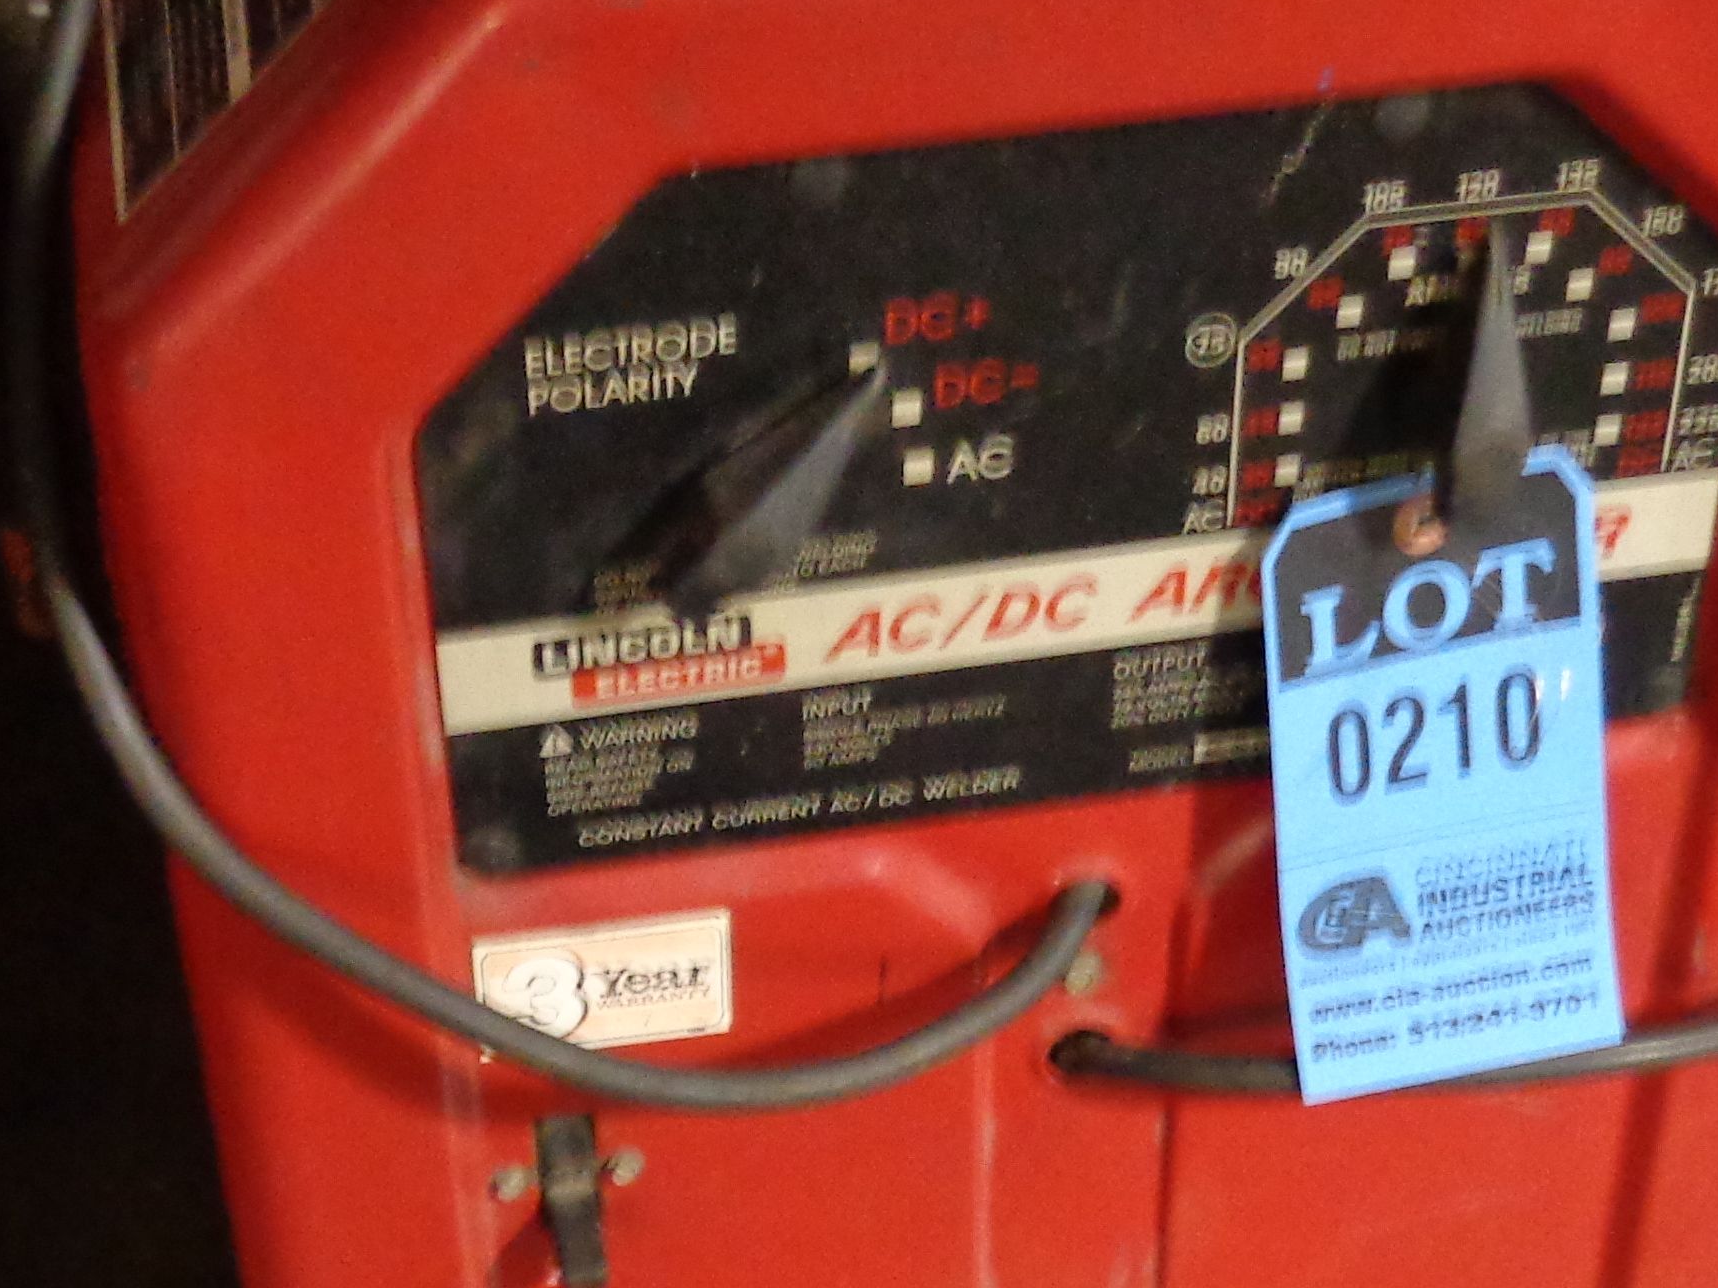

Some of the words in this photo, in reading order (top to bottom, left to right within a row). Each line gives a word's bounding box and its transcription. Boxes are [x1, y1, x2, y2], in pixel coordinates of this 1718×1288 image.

[525, 311, 738, 380] ELECTRODE
[527, 361, 699, 417] POLARITY
[945, 433, 1015, 486] AC
[821, 570, 1099, 664] AC/DC
[1300, 537, 1557, 674] LOT
[535, 614, 756, 680] LINCOLN
[595, 652, 764, 700] ELECTRIC
[1326, 663, 1542, 806] 0210
